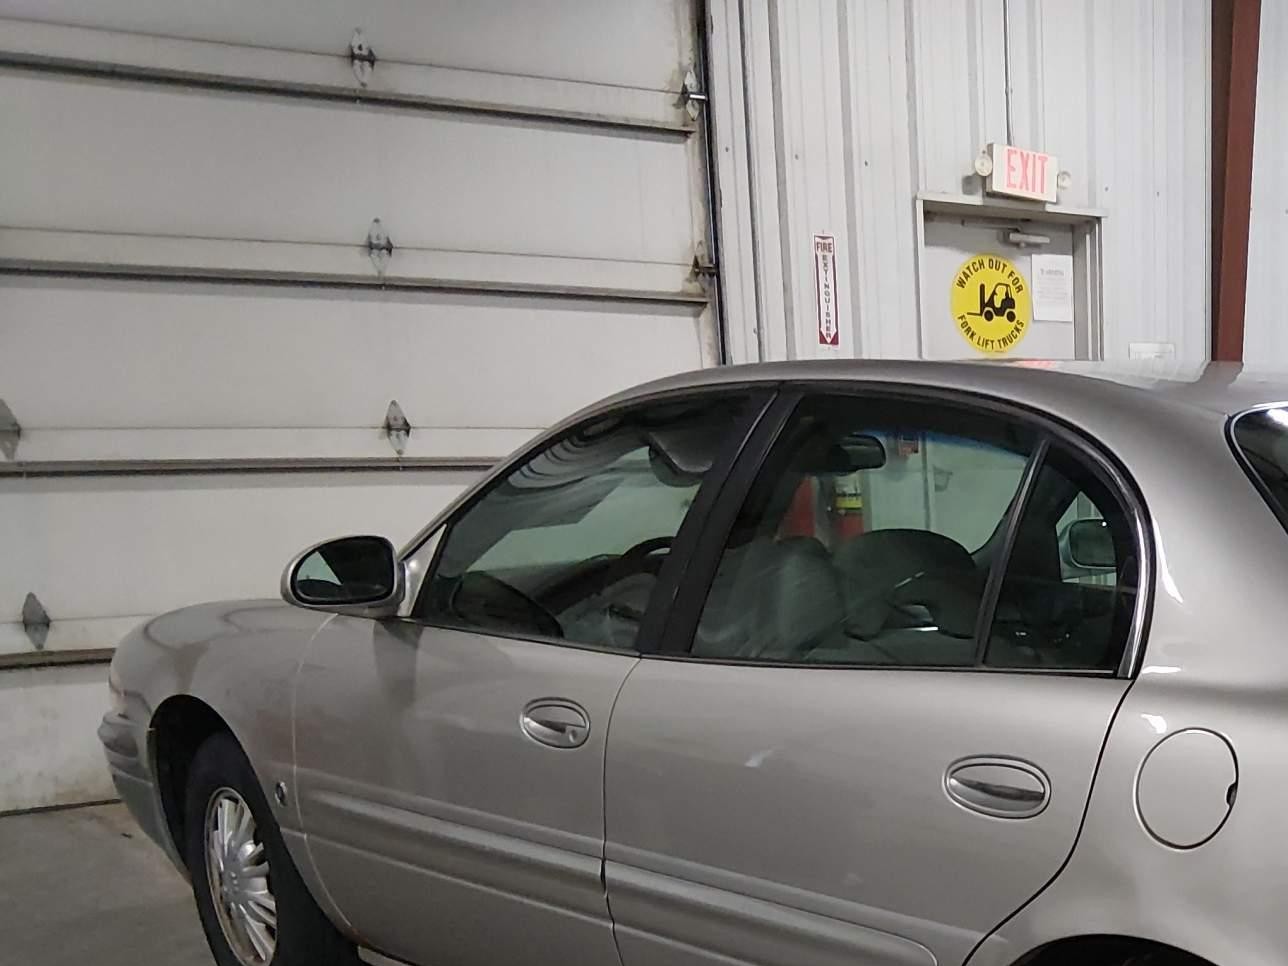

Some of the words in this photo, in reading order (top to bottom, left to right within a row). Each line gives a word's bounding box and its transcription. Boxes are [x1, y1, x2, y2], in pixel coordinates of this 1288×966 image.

[1006, 148, 1049, 194] EXIT
[816, 242, 832, 253] FIRE
[956, 258, 985, 289] WATCH
[988, 258, 1008, 274] OUT
[1007, 270, 1024, 294] FOR
[822, 254, 832, 339] EXTINGUISHER
[957, 314, 977, 341] FORK
[976, 336, 995, 350] LIFT
[997, 319, 1025, 349] TRUCKS
